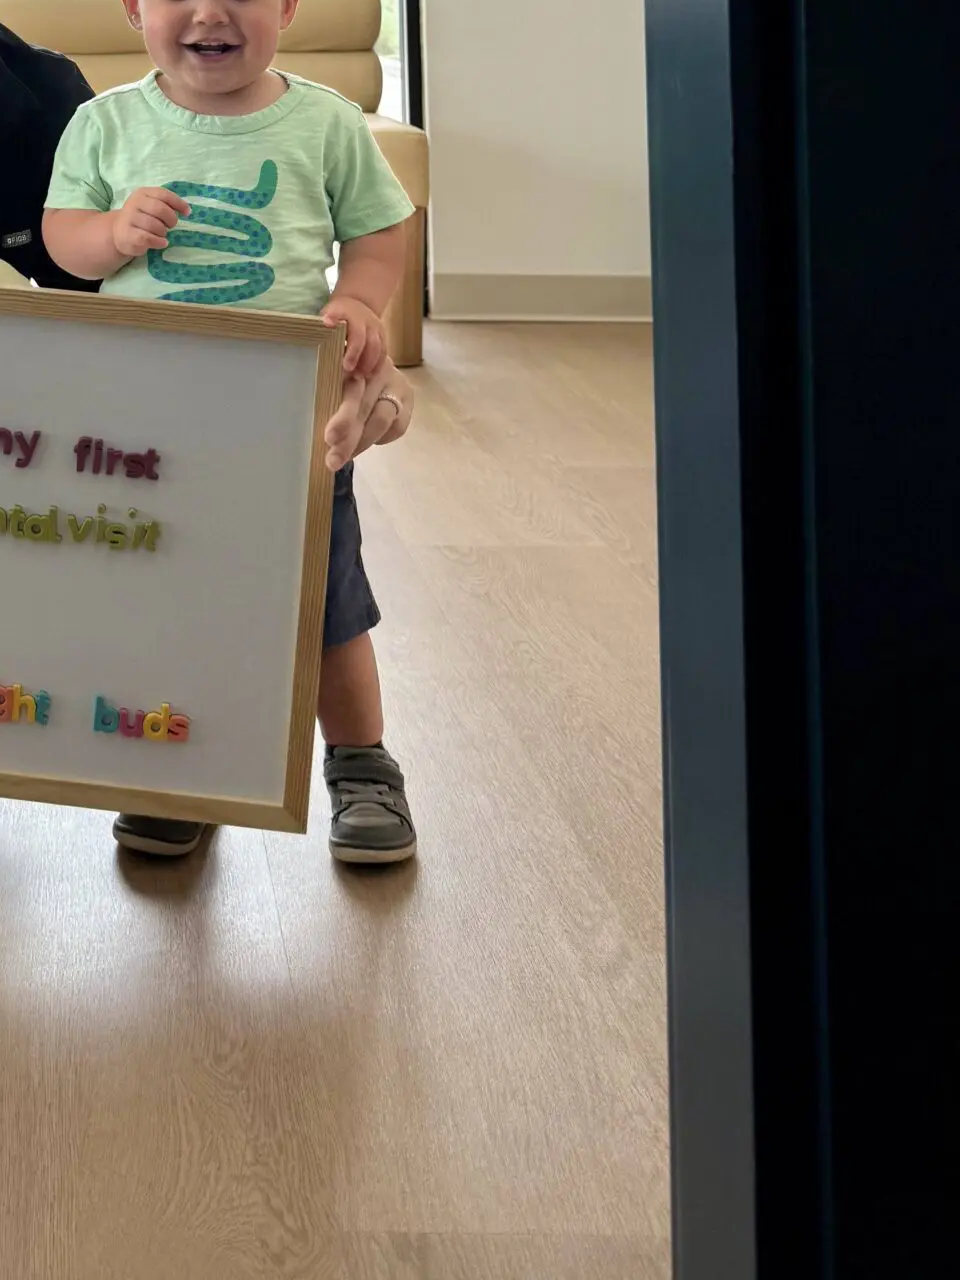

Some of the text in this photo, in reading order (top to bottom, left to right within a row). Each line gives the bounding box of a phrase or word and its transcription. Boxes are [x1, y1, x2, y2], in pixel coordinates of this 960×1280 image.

[74, 435, 161, 480] first
[68, 503, 161, 552] visit
[93, 695, 191, 743] buds
